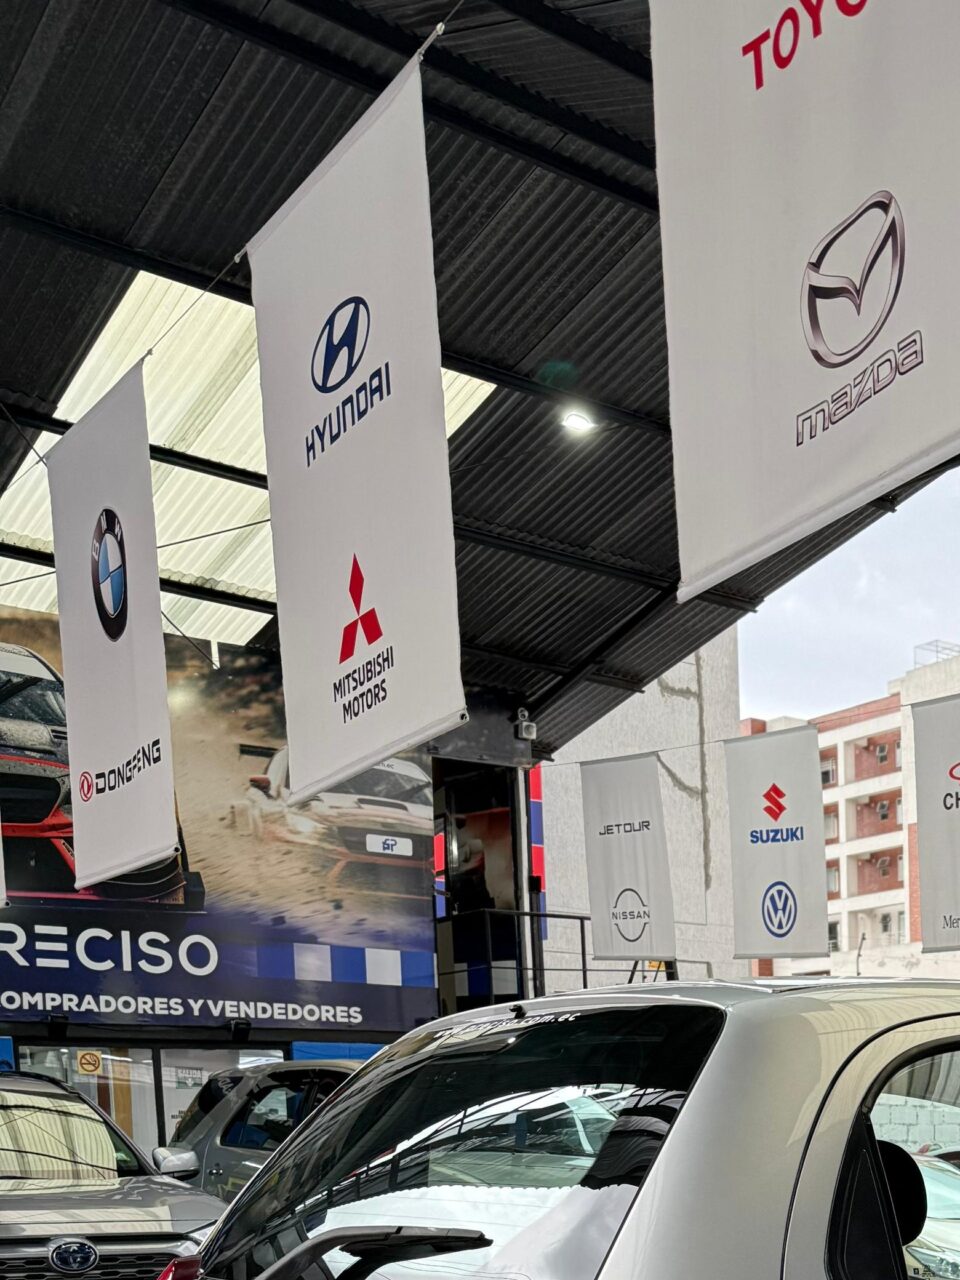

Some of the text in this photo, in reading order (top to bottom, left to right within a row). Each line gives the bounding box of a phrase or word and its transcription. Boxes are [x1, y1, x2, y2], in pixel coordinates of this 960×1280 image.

[741, 0, 868, 91] TOY
[305, 361, 392, 468] HYUNDAI
[333, 645, 394, 703] MITSUBISHI
[342, 678, 387, 724] MOTORS
[95, 738, 162, 794] DONGFENG
[599, 820, 651, 836] JETOUR
[749, 826, 804, 845] SUZUKI
[611, 909, 651, 921] NISSAN
[0, 990, 363, 1024] OMPRADORES Y VENDEDORES
